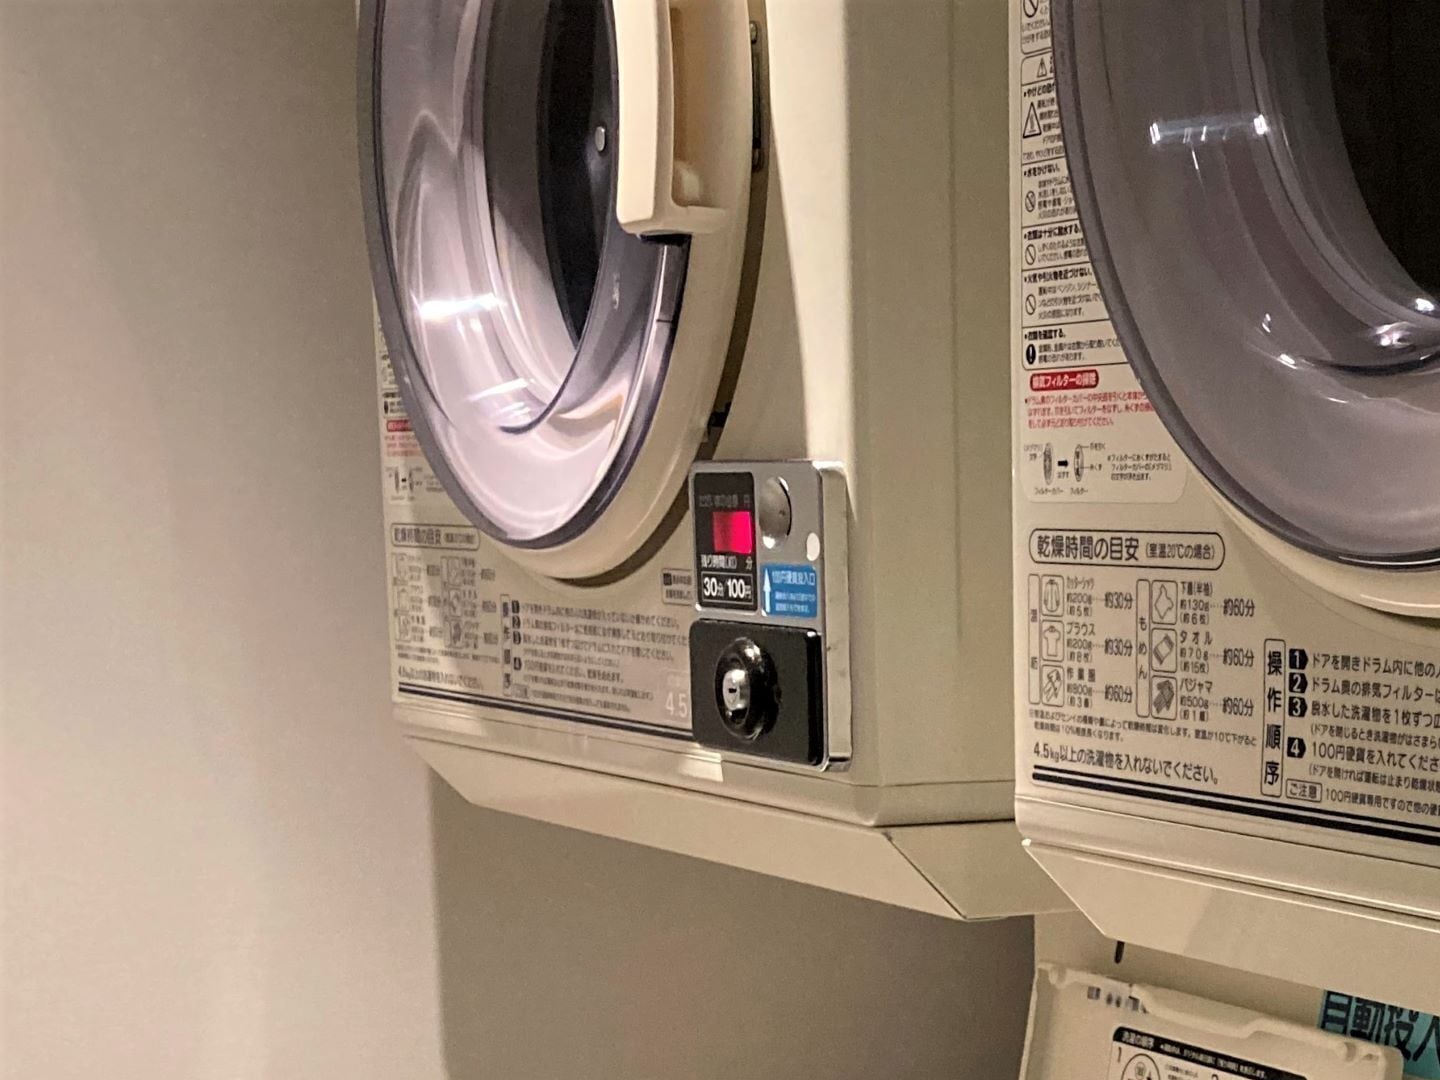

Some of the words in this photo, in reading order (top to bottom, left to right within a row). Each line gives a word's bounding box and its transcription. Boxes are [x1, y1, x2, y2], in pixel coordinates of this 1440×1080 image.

[1037, 535, 1140, 562] 乾燥時間の目安
[1104, 591, 1133, 610] 約30分
[1223, 598, 1255, 617] 約60分
[1066, 622, 1095, 637] ブラウス
[1104, 639, 1133, 658] 約30分
[1222, 648, 1254, 668] 約60分
[1291, 675, 1302, 693] 2
[1104, 685, 1133, 703] 約60分
[1222, 697, 1254, 717] 約60分
[1291, 699, 1302, 717] 3
[1264, 650, 1283, 787] 操作順序
[1289, 739, 1301, 757] 4
[1287, 782, 1318, 800] ご注意
[1117, 1047, 1122, 1063] 1
